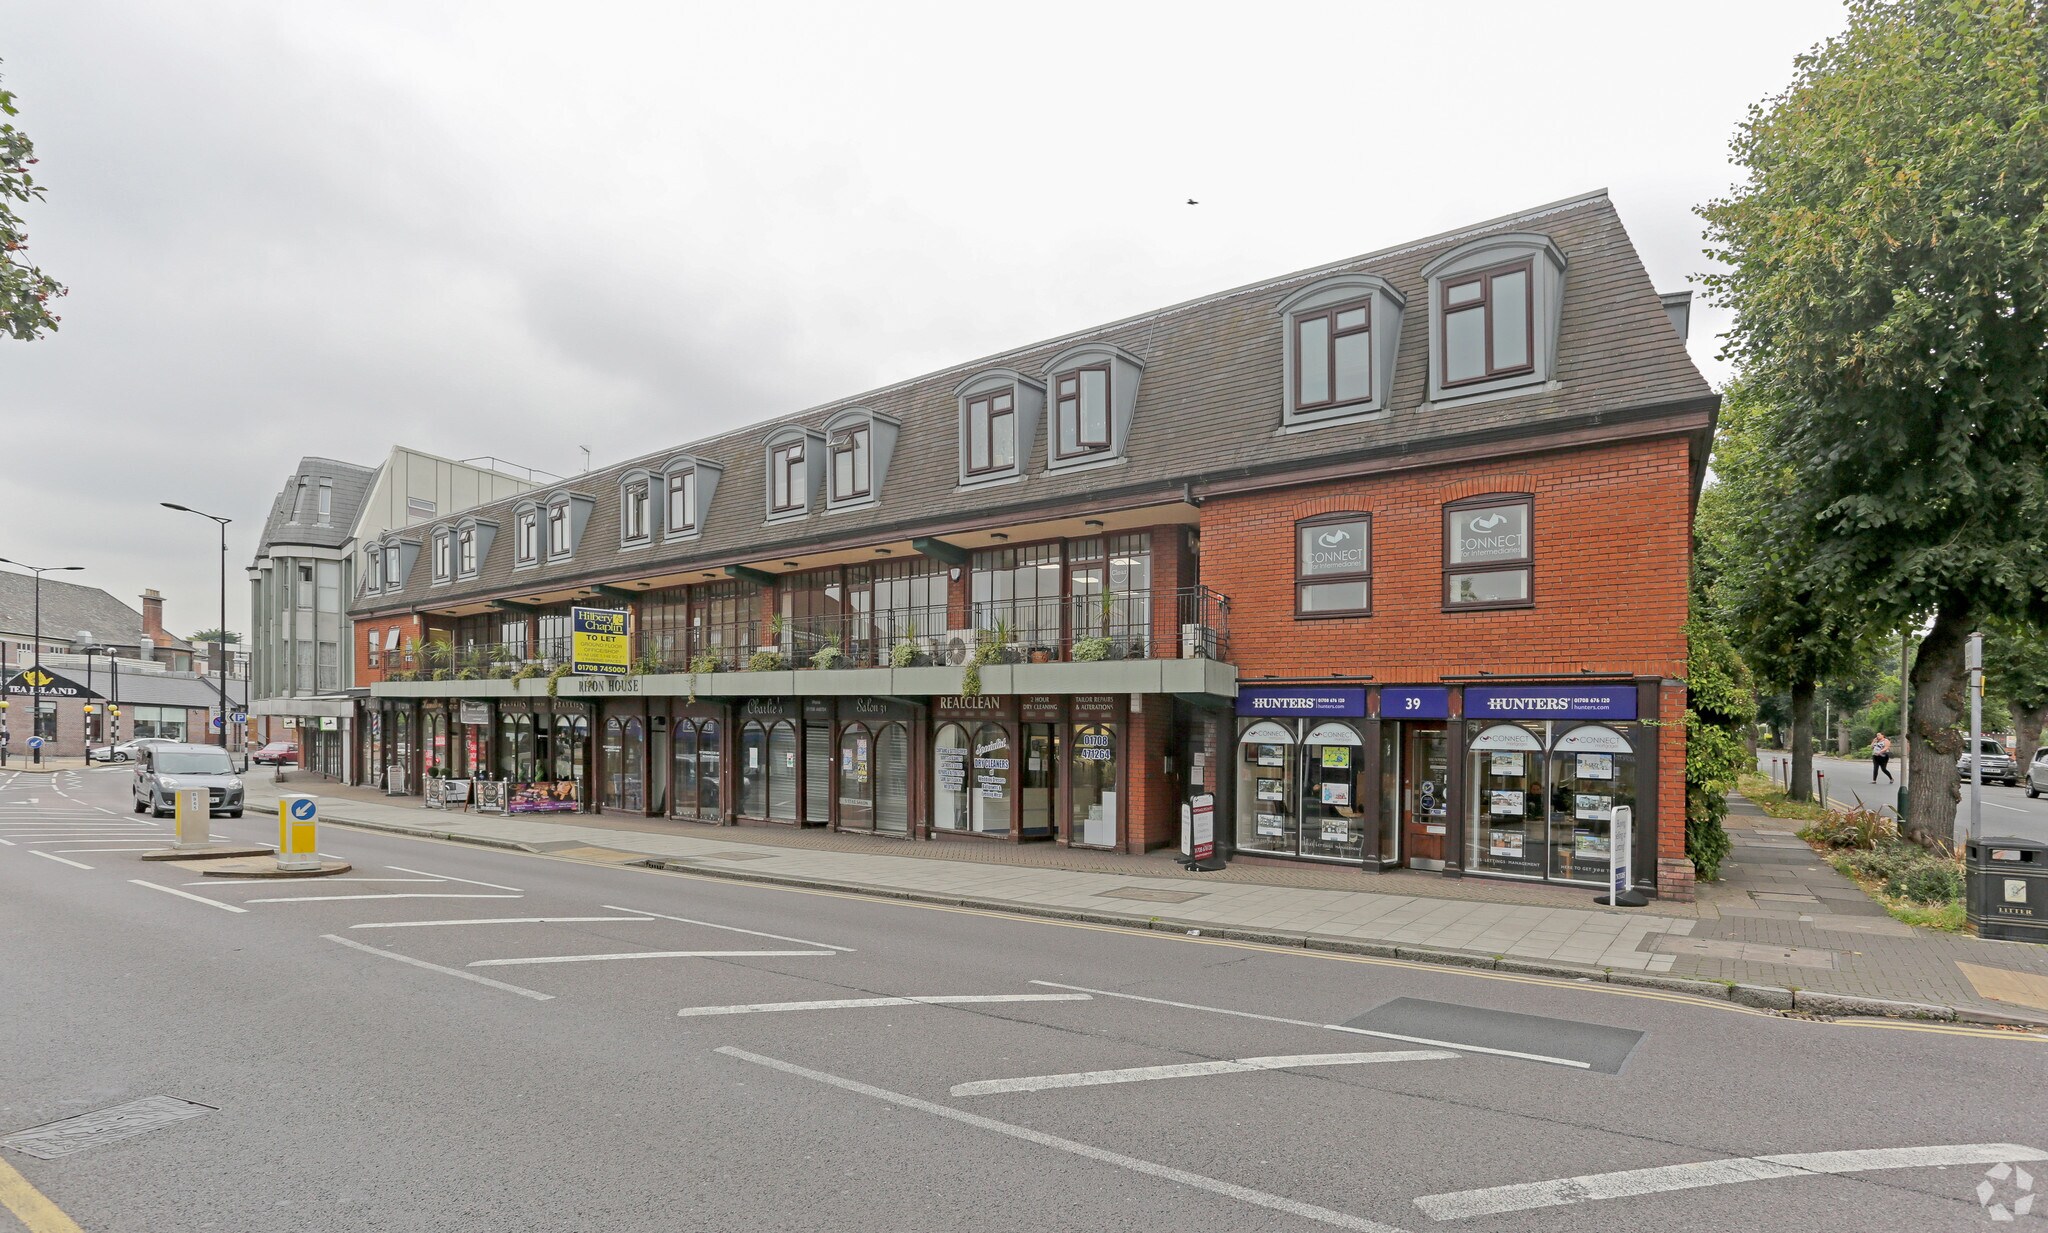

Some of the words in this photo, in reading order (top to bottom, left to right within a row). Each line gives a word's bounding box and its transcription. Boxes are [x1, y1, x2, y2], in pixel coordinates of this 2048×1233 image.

[579, 611, 613, 624] Hilbery
[585, 620, 623, 633] Chaplin
[608, 680, 638, 692] HOUSE
[747, 697, 783, 714] Charlie's
[857, 698, 879, 713] Salon
[880, 704, 887, 713] 31
[940, 696, 1000, 709] REALCLEAN
[1252, 698, 1314, 708] HUNTERS
[1406, 698, 1420, 709] 39
[1487, 698, 1568, 710] HUNTERS
[1083, 735, 1108, 747] 01708
[1081, 748, 1110, 760] 471264
[974, 758, 985, 768] DRY
[985, 759, 1009, 769] CLEANERS
